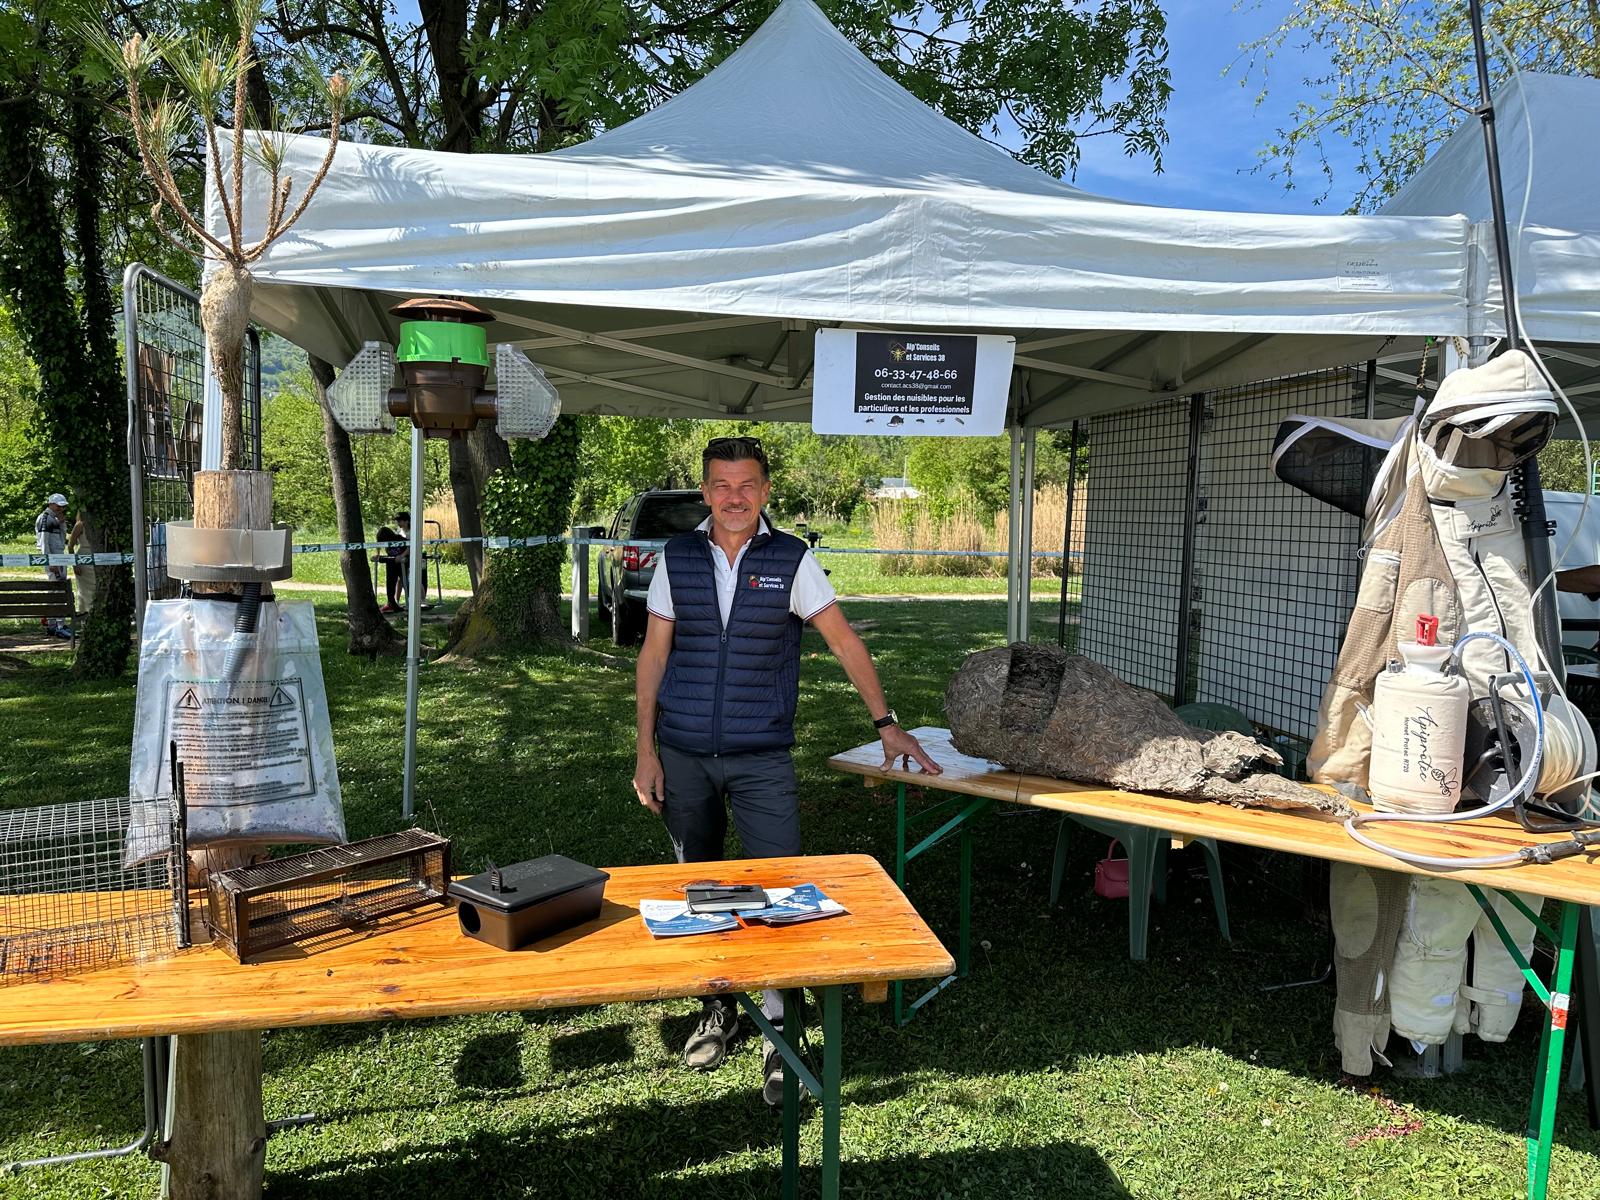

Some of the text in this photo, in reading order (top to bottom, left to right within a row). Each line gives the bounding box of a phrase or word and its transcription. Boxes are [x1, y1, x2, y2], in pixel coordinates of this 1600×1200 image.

[906, 342, 940, 352] Alp'Conseils
[913, 353, 937, 362] Services
[938, 354, 946, 362] 38
[874, 368, 958, 380] 06-33-47-48-66
[881, 382, 952, 391] contact.acs38@gmail.com
[864, 392, 966, 404] Gestion des nuisibles pour les
[858, 403, 970, 415] particuliers et les professionnels
[1410, 706, 1439, 782] Apiprotec
